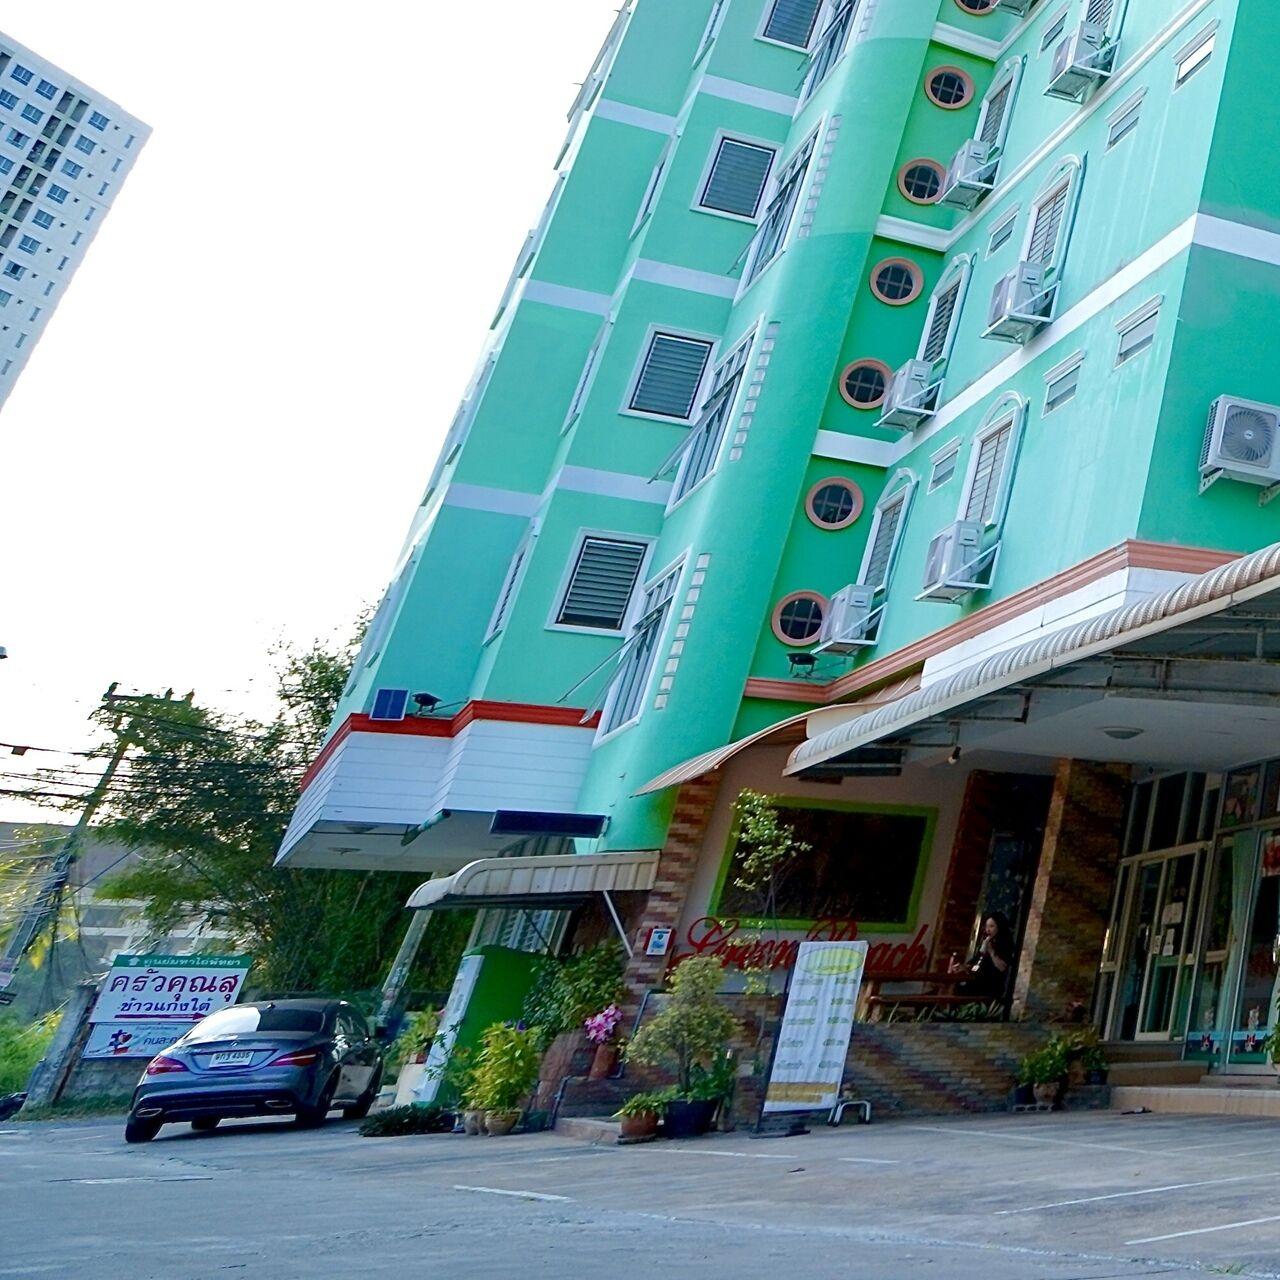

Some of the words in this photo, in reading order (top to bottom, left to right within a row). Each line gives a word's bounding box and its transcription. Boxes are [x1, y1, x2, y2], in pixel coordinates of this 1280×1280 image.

[109, 968, 240, 1003] ครัวคุณสุ
[120, 997, 214, 1013] ข้าวแกงใต้
